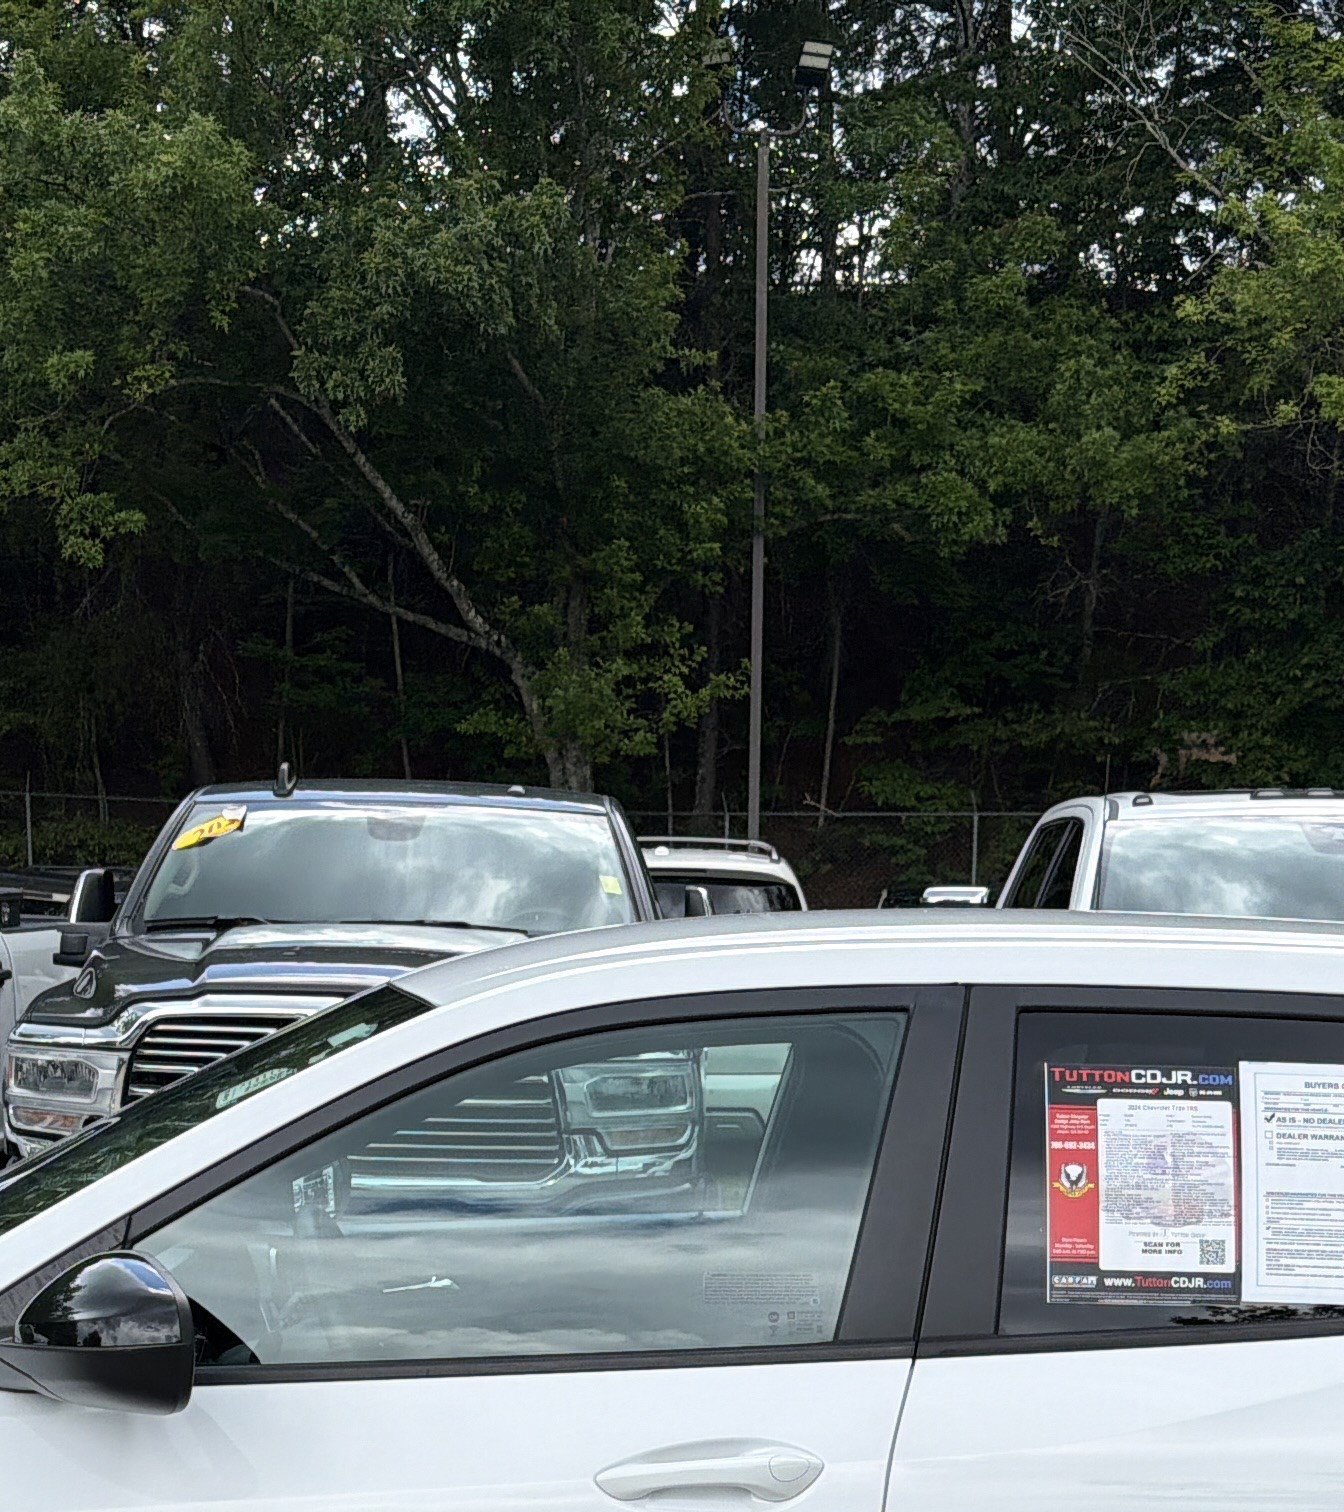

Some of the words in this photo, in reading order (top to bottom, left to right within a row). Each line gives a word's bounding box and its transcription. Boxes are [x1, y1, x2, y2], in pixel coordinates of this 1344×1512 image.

[1304, 1081, 1340, 1090] BUYERS
[1276, 1116, 1287, 1124] AS
[1276, 1132, 1308, 1140] DEALER
